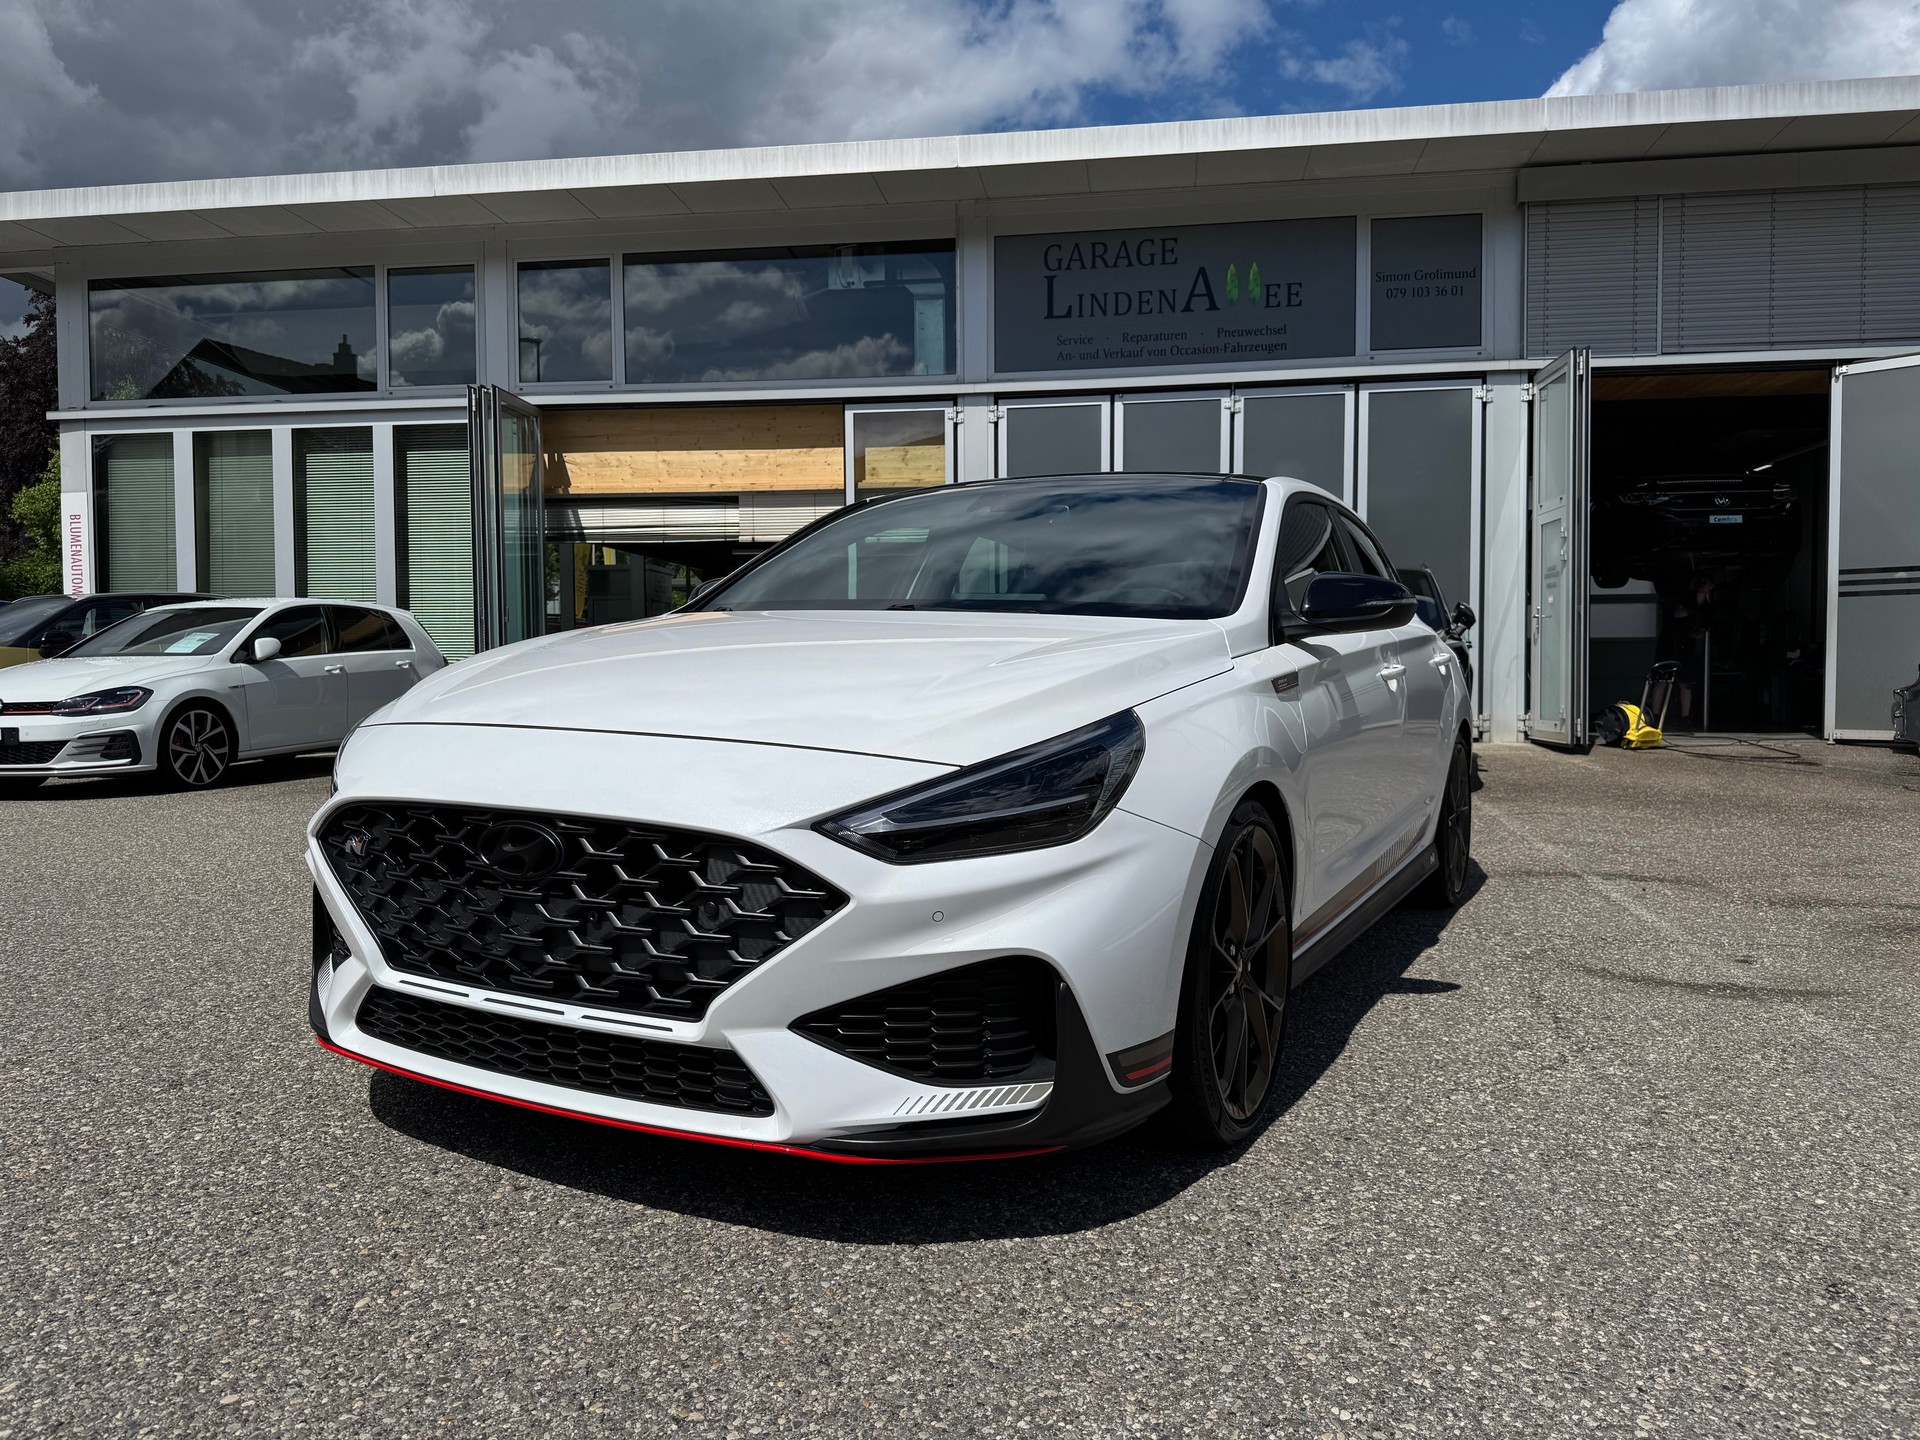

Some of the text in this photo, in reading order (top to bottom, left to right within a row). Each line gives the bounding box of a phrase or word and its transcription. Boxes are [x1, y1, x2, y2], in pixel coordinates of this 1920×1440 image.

[1043, 237, 1178, 271] GARAGE
[1375, 267, 1476, 283] Simon Grolimund
[1386, 285, 1464, 299] 079 103 36 01
[1056, 324, 1287, 346] Service Reparaturen Pneuwechsel
[1056, 340, 1288, 362] An- und Verkauf von Occasion-Fahrzeugen
